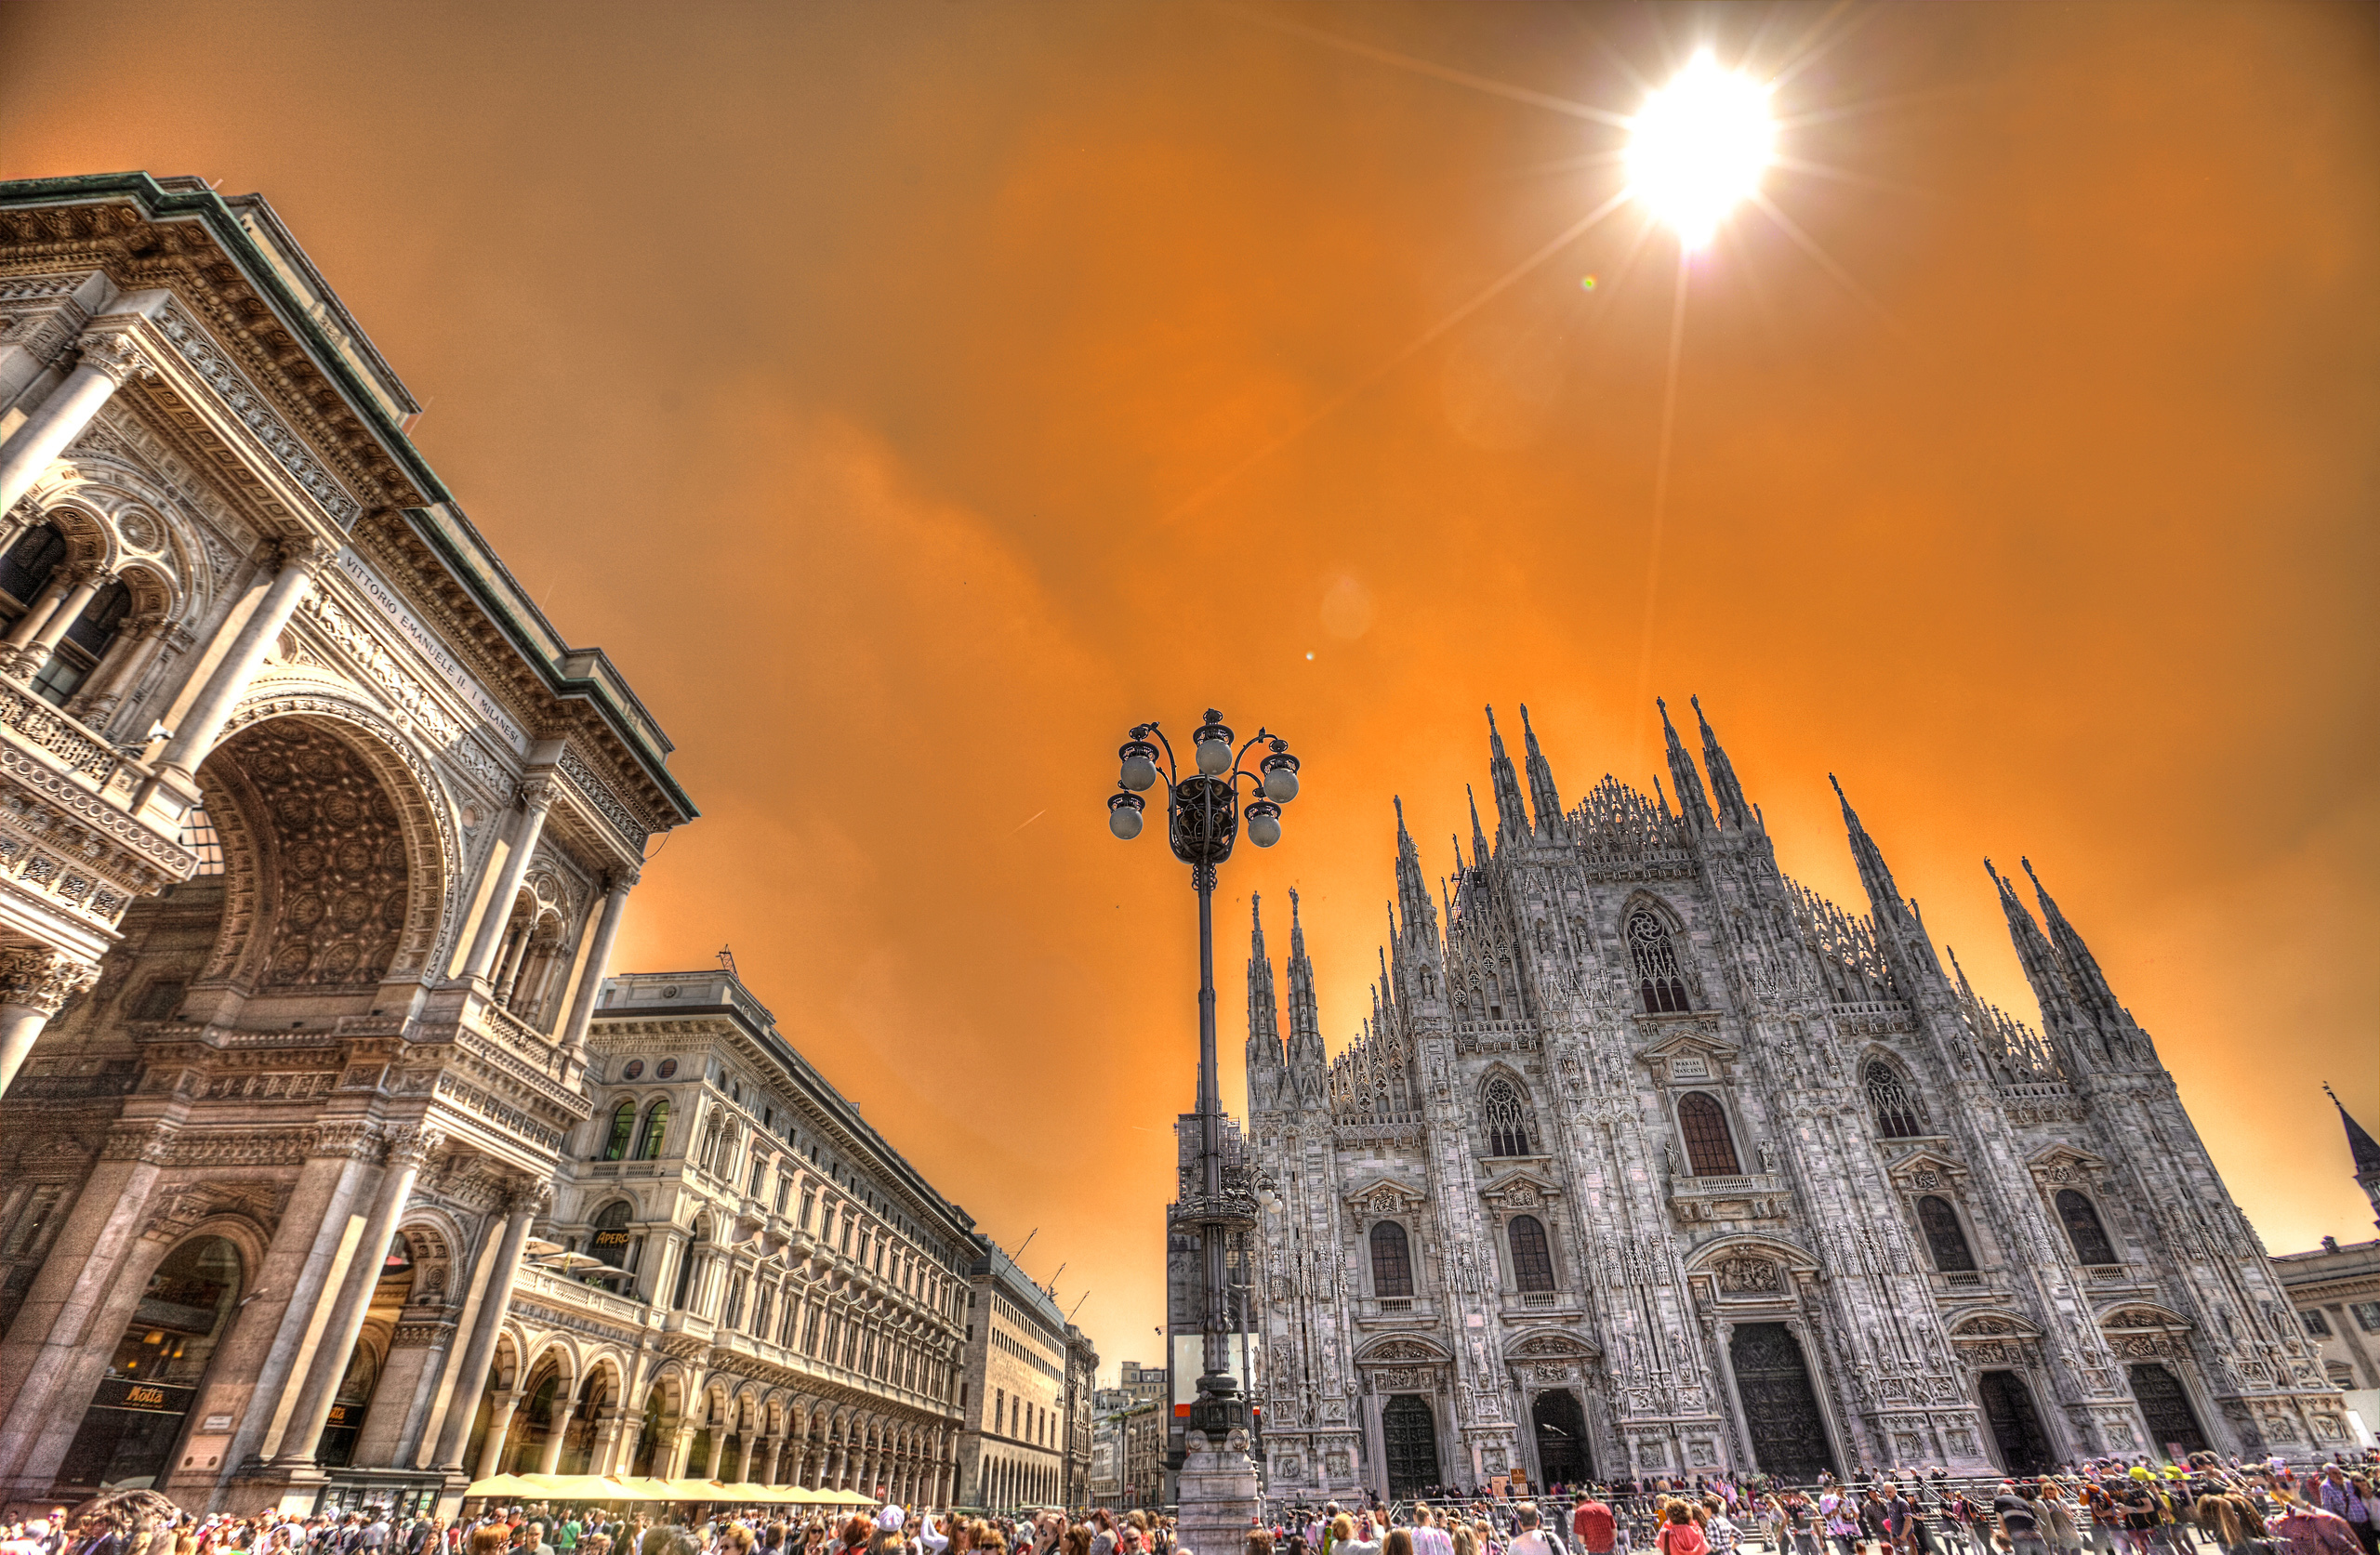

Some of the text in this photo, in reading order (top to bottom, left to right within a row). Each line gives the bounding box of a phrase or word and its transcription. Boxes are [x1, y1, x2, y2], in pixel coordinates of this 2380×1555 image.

[346, 556, 519, 743] VITTORIO EMANUELE II. I MILANESI
[126, 1385, 165, 1404] Motta
